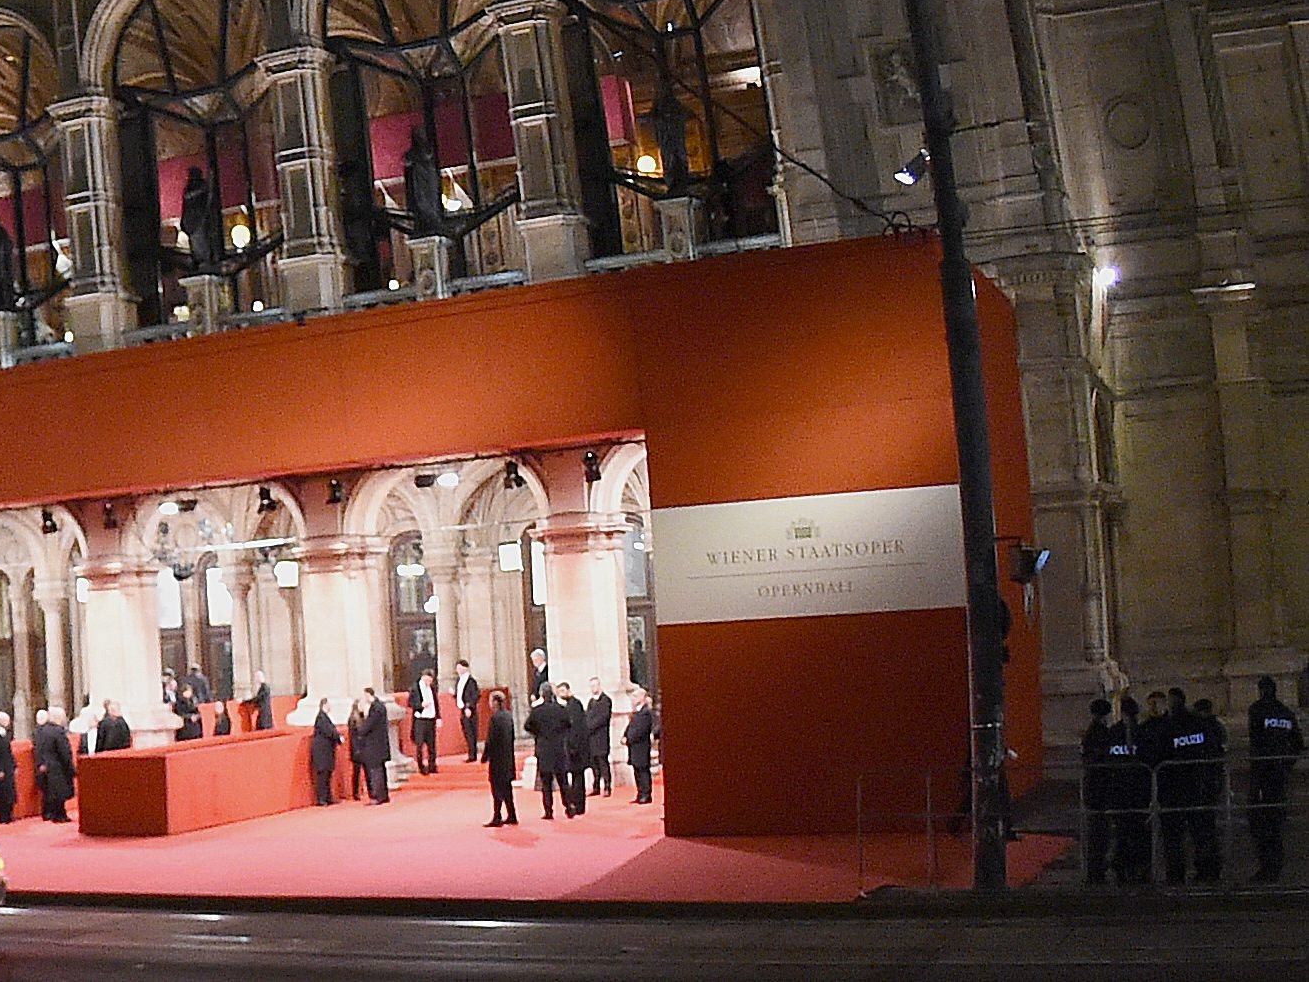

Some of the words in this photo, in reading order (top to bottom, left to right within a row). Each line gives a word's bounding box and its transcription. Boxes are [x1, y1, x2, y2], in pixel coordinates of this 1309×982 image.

[706, 549, 778, 565] WIENER
[786, 538, 905, 560] STAATSOPER
[1173, 732, 1205, 748] POLIZEI
